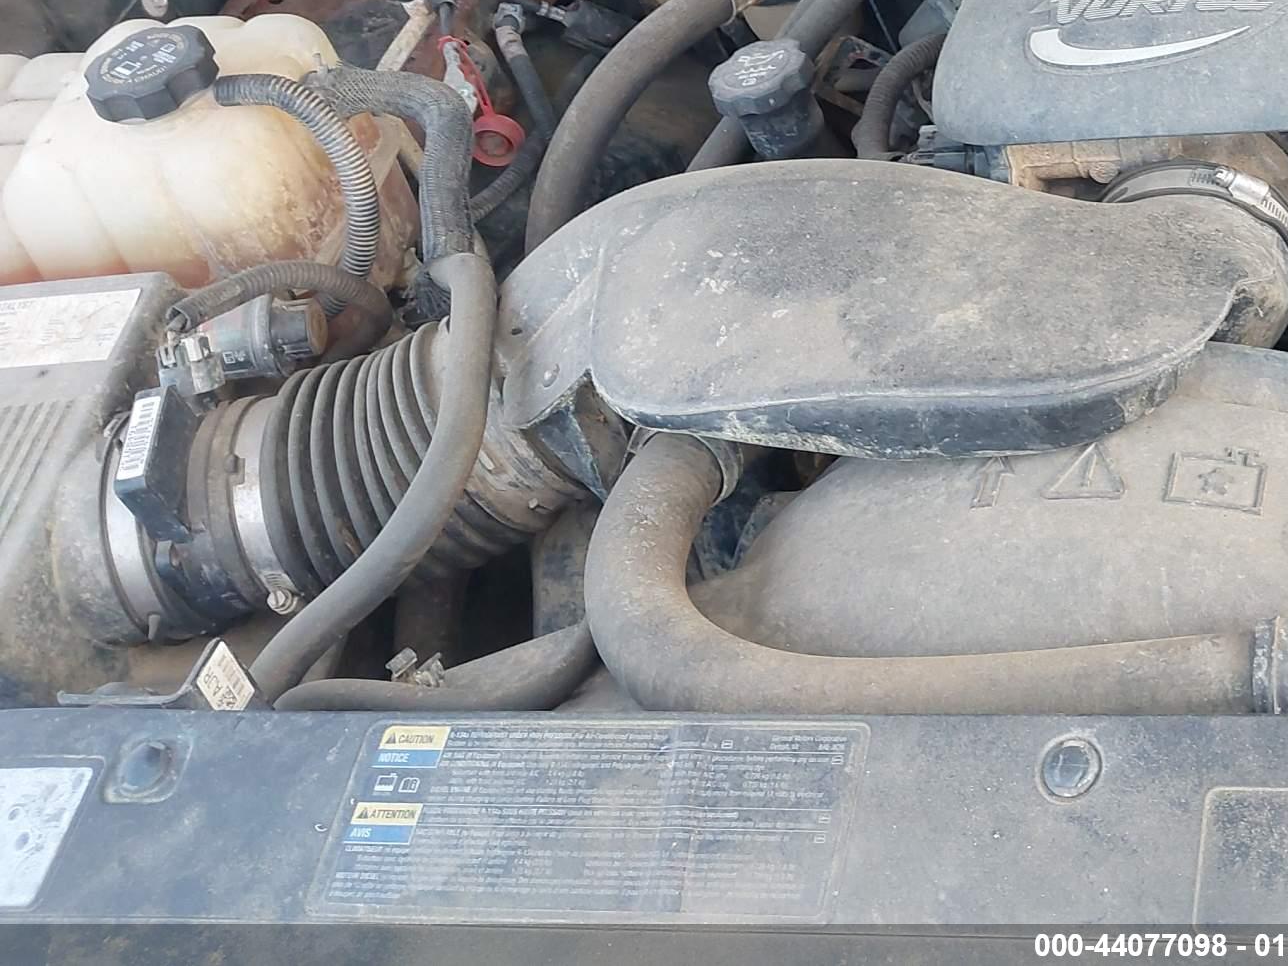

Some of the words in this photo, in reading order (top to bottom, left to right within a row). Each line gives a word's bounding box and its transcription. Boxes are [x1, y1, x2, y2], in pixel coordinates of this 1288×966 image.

[399, 733, 435, 744] CAUTION
[378, 753, 410, 763] NOTICE
[369, 809, 417, 819] ATTENTION
[350, 828, 372, 838] AVIS
